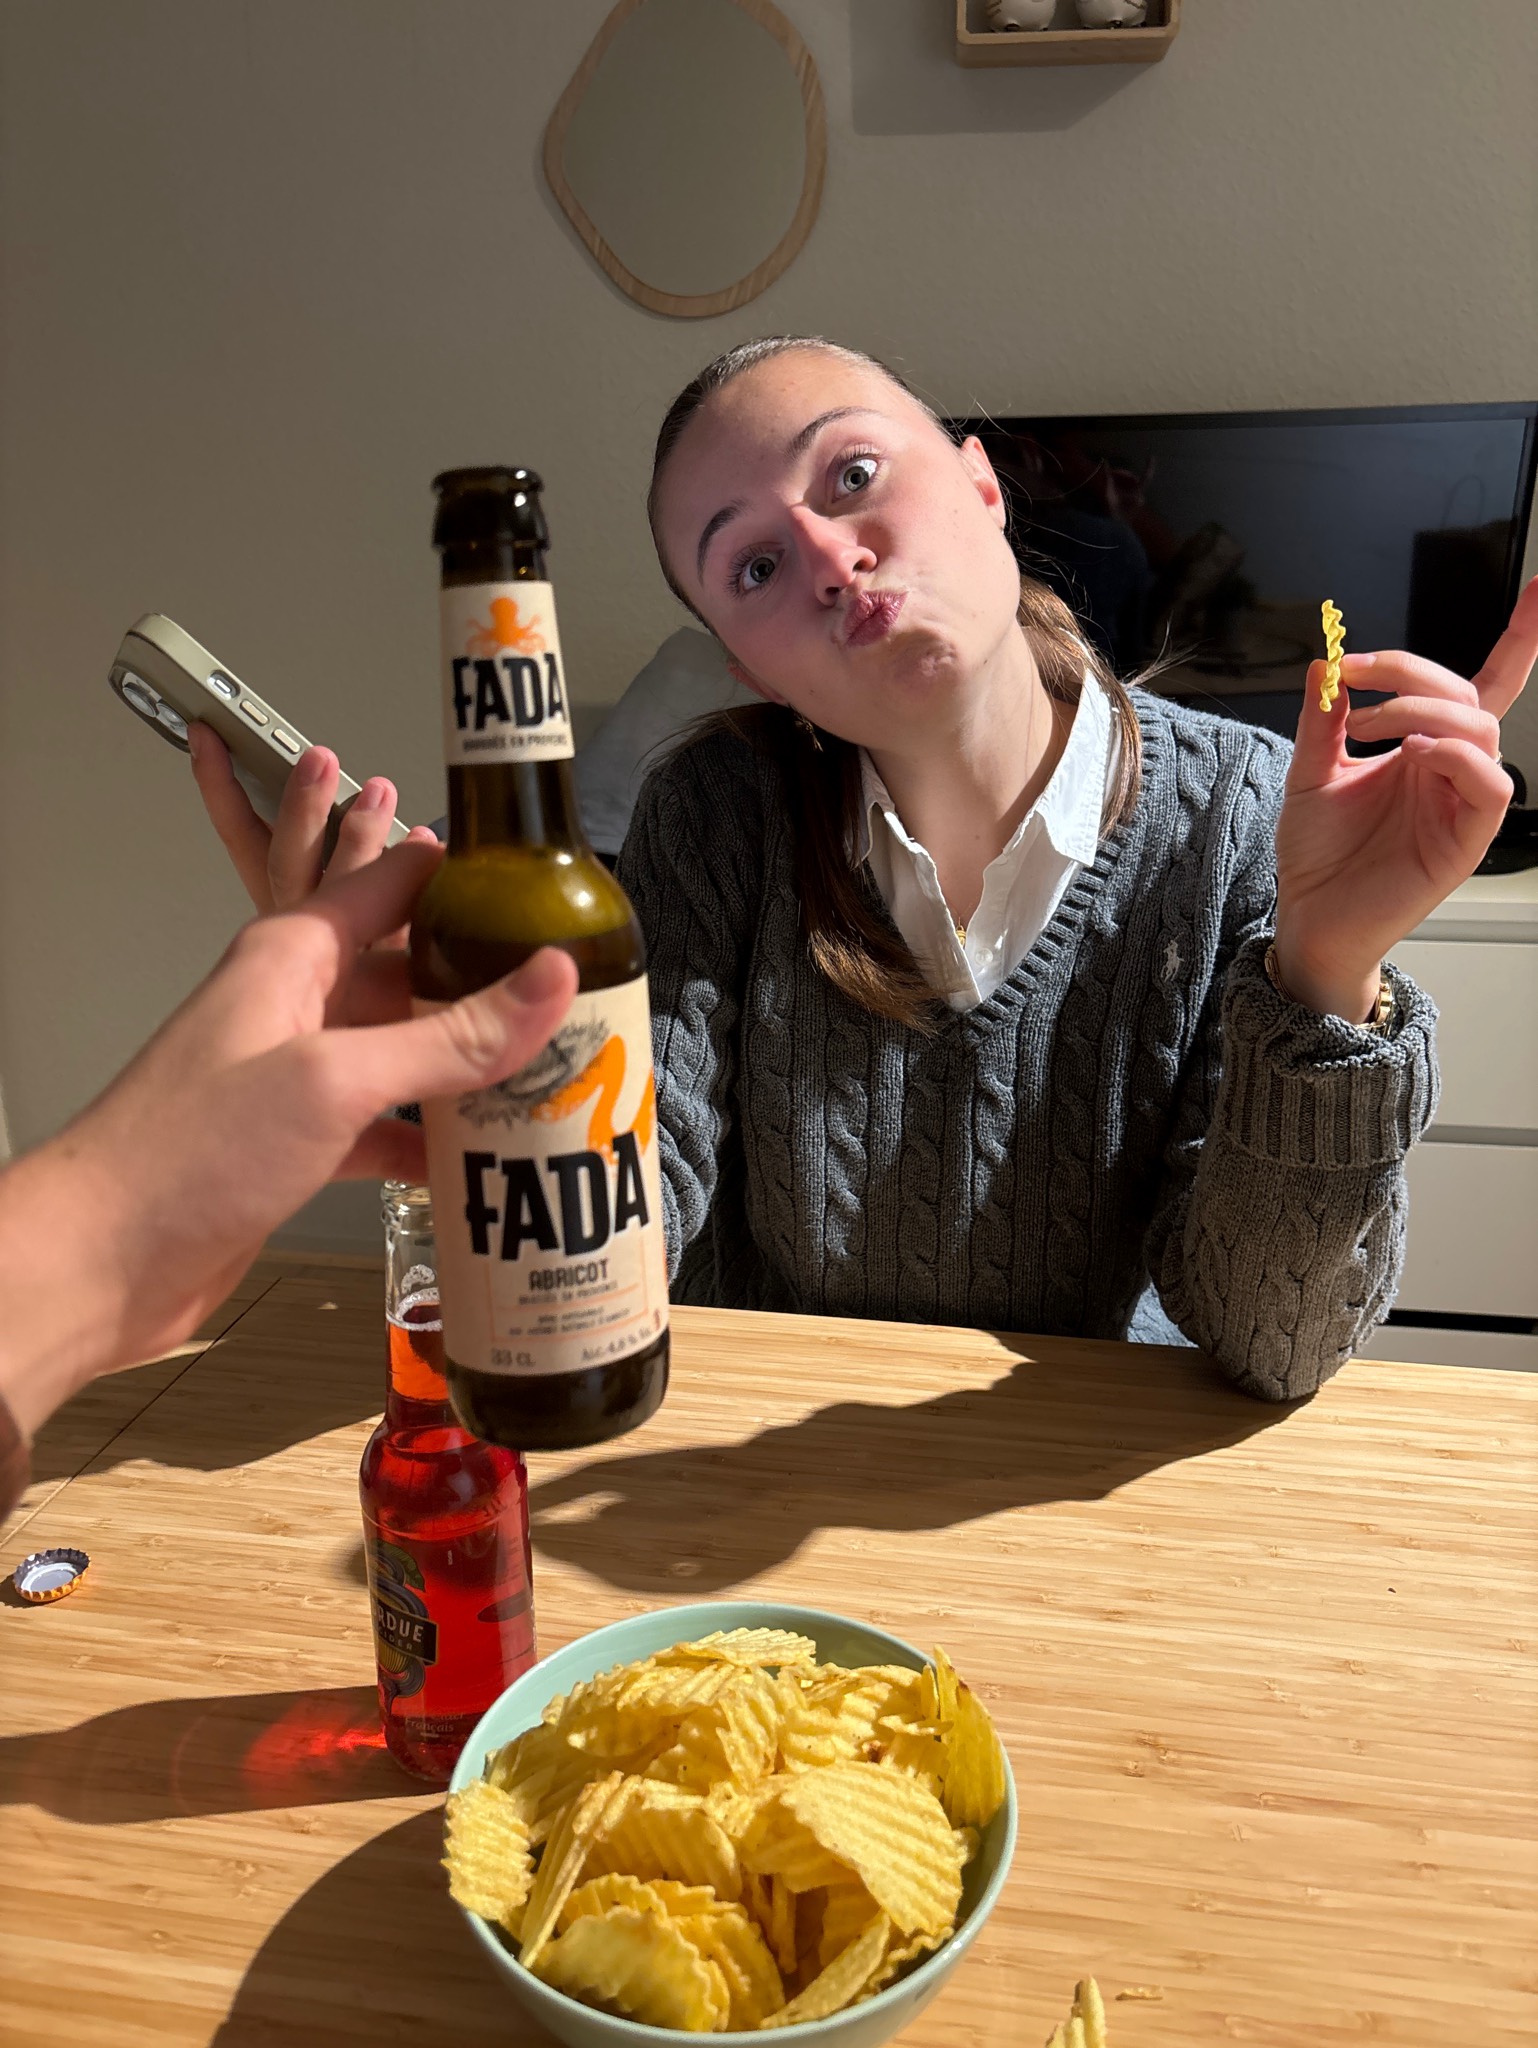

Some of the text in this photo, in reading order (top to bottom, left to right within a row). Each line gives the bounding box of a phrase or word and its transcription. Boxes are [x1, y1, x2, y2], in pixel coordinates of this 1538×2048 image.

[453, 652, 568, 732] FADA
[464, 1131, 650, 1261] FADA
[528, 1257, 608, 1291] ABRICOT
